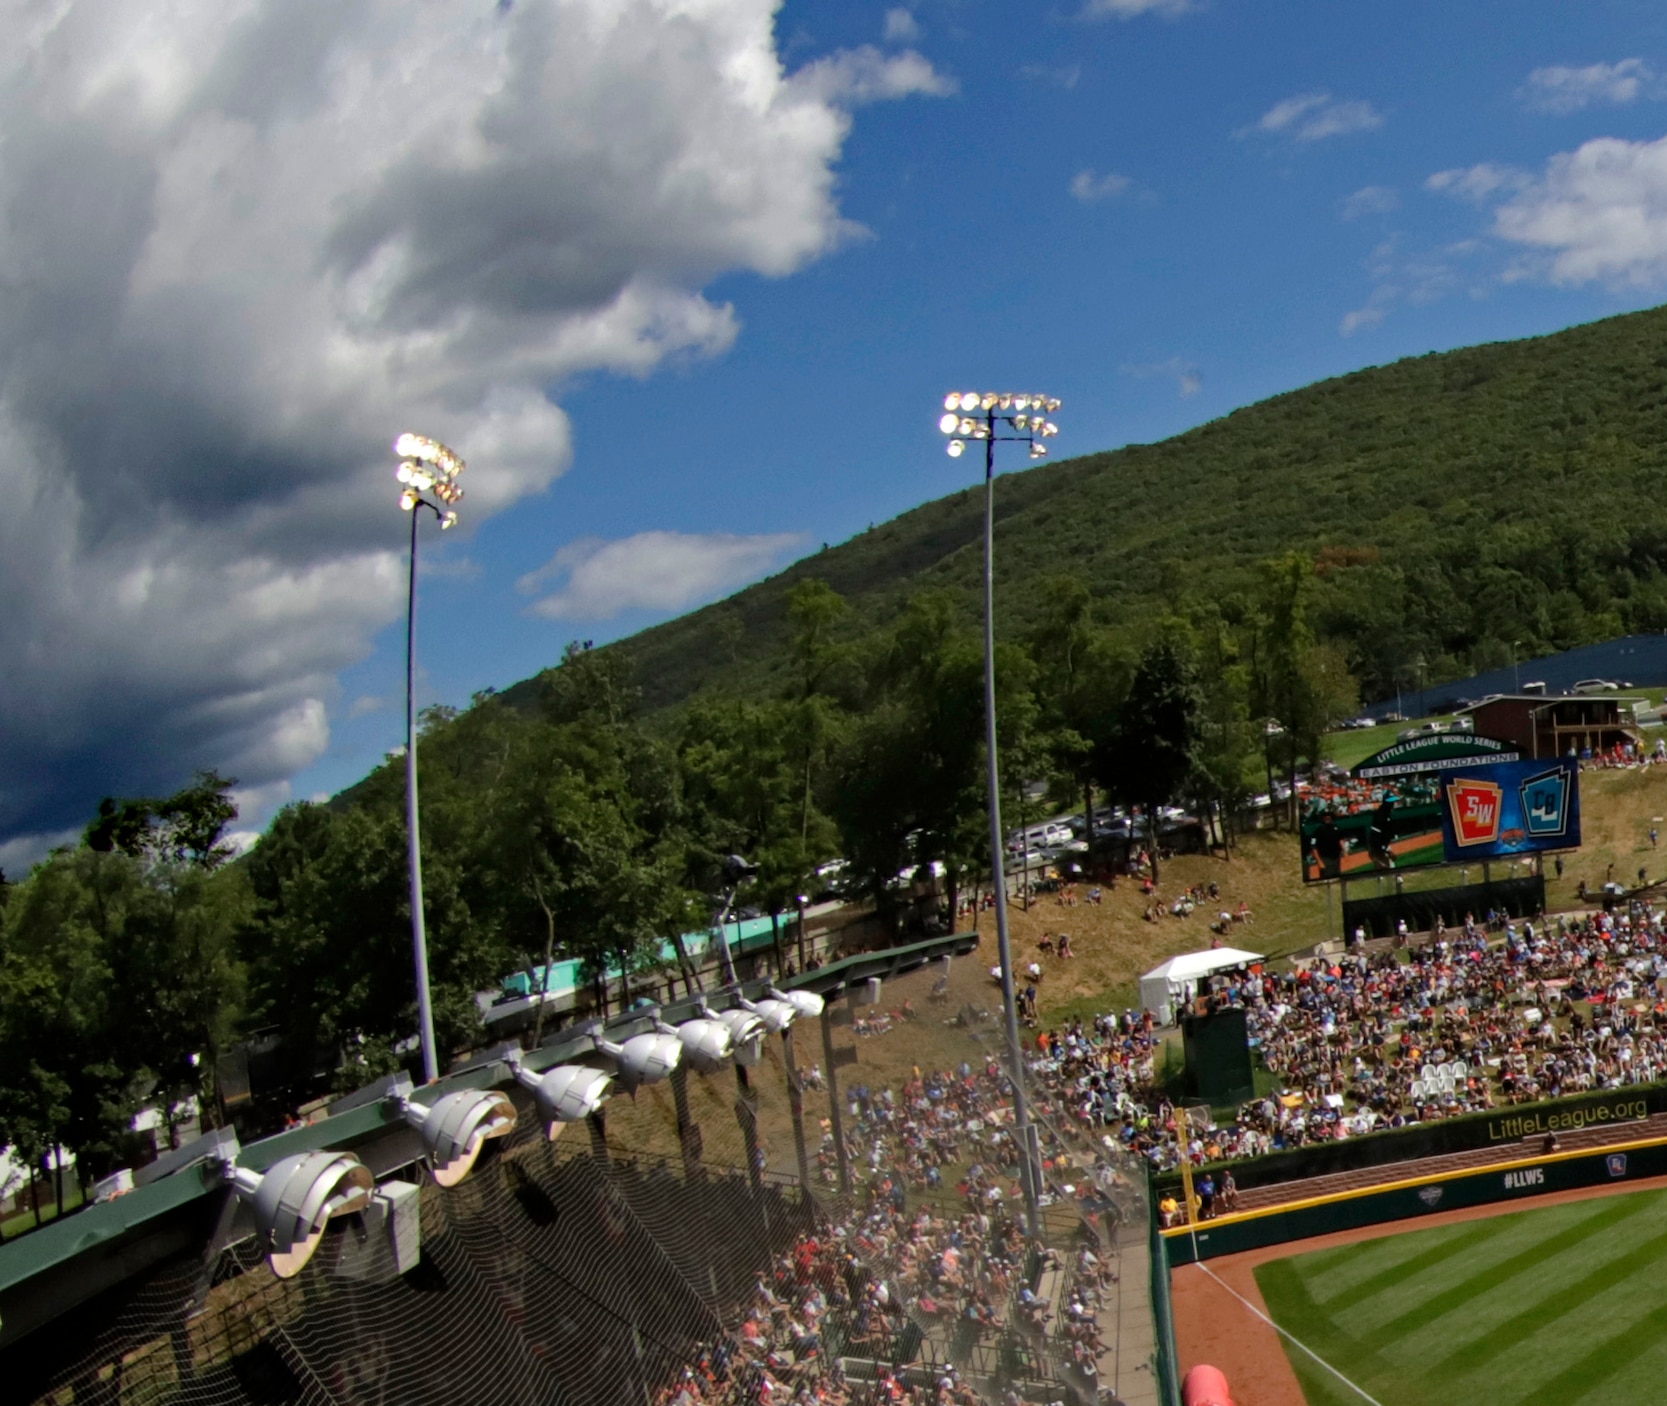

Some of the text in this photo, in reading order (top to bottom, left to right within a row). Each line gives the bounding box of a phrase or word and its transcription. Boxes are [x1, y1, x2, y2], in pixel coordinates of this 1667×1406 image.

[1376, 735, 1502, 763] LITTLE LEAGUE WORLD SERIES
[1362, 753, 1518, 778] EASTON FOUNDATIONS
[1488, 1100, 1648, 1141] LittleLeague.org
[1503, 1167, 1545, 1190] #LLWS
